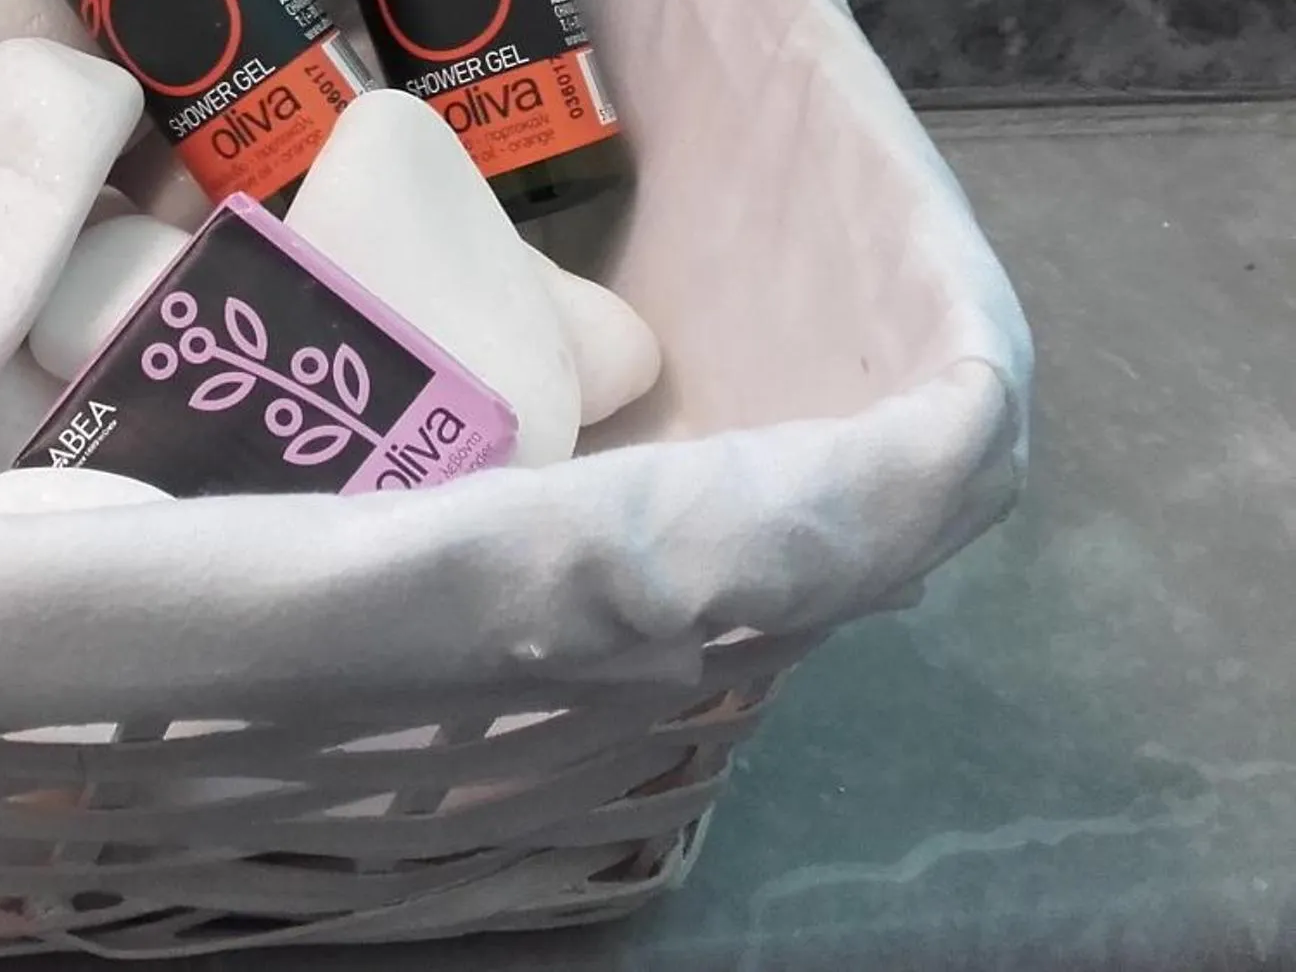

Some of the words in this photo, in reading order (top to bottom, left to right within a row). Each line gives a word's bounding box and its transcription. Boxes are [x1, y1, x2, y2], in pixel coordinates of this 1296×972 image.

[169, 81, 238, 138] SHOWER
[232, 57, 276, 92] GEL
[405, 57, 485, 98] SHOWER
[485, 44, 530, 73] GEL
[443, 77, 543, 133] oliva
[211, 85, 303, 160] oliva
[48, 400, 117, 468] ABEA
[376, 407, 466, 490] oliva
